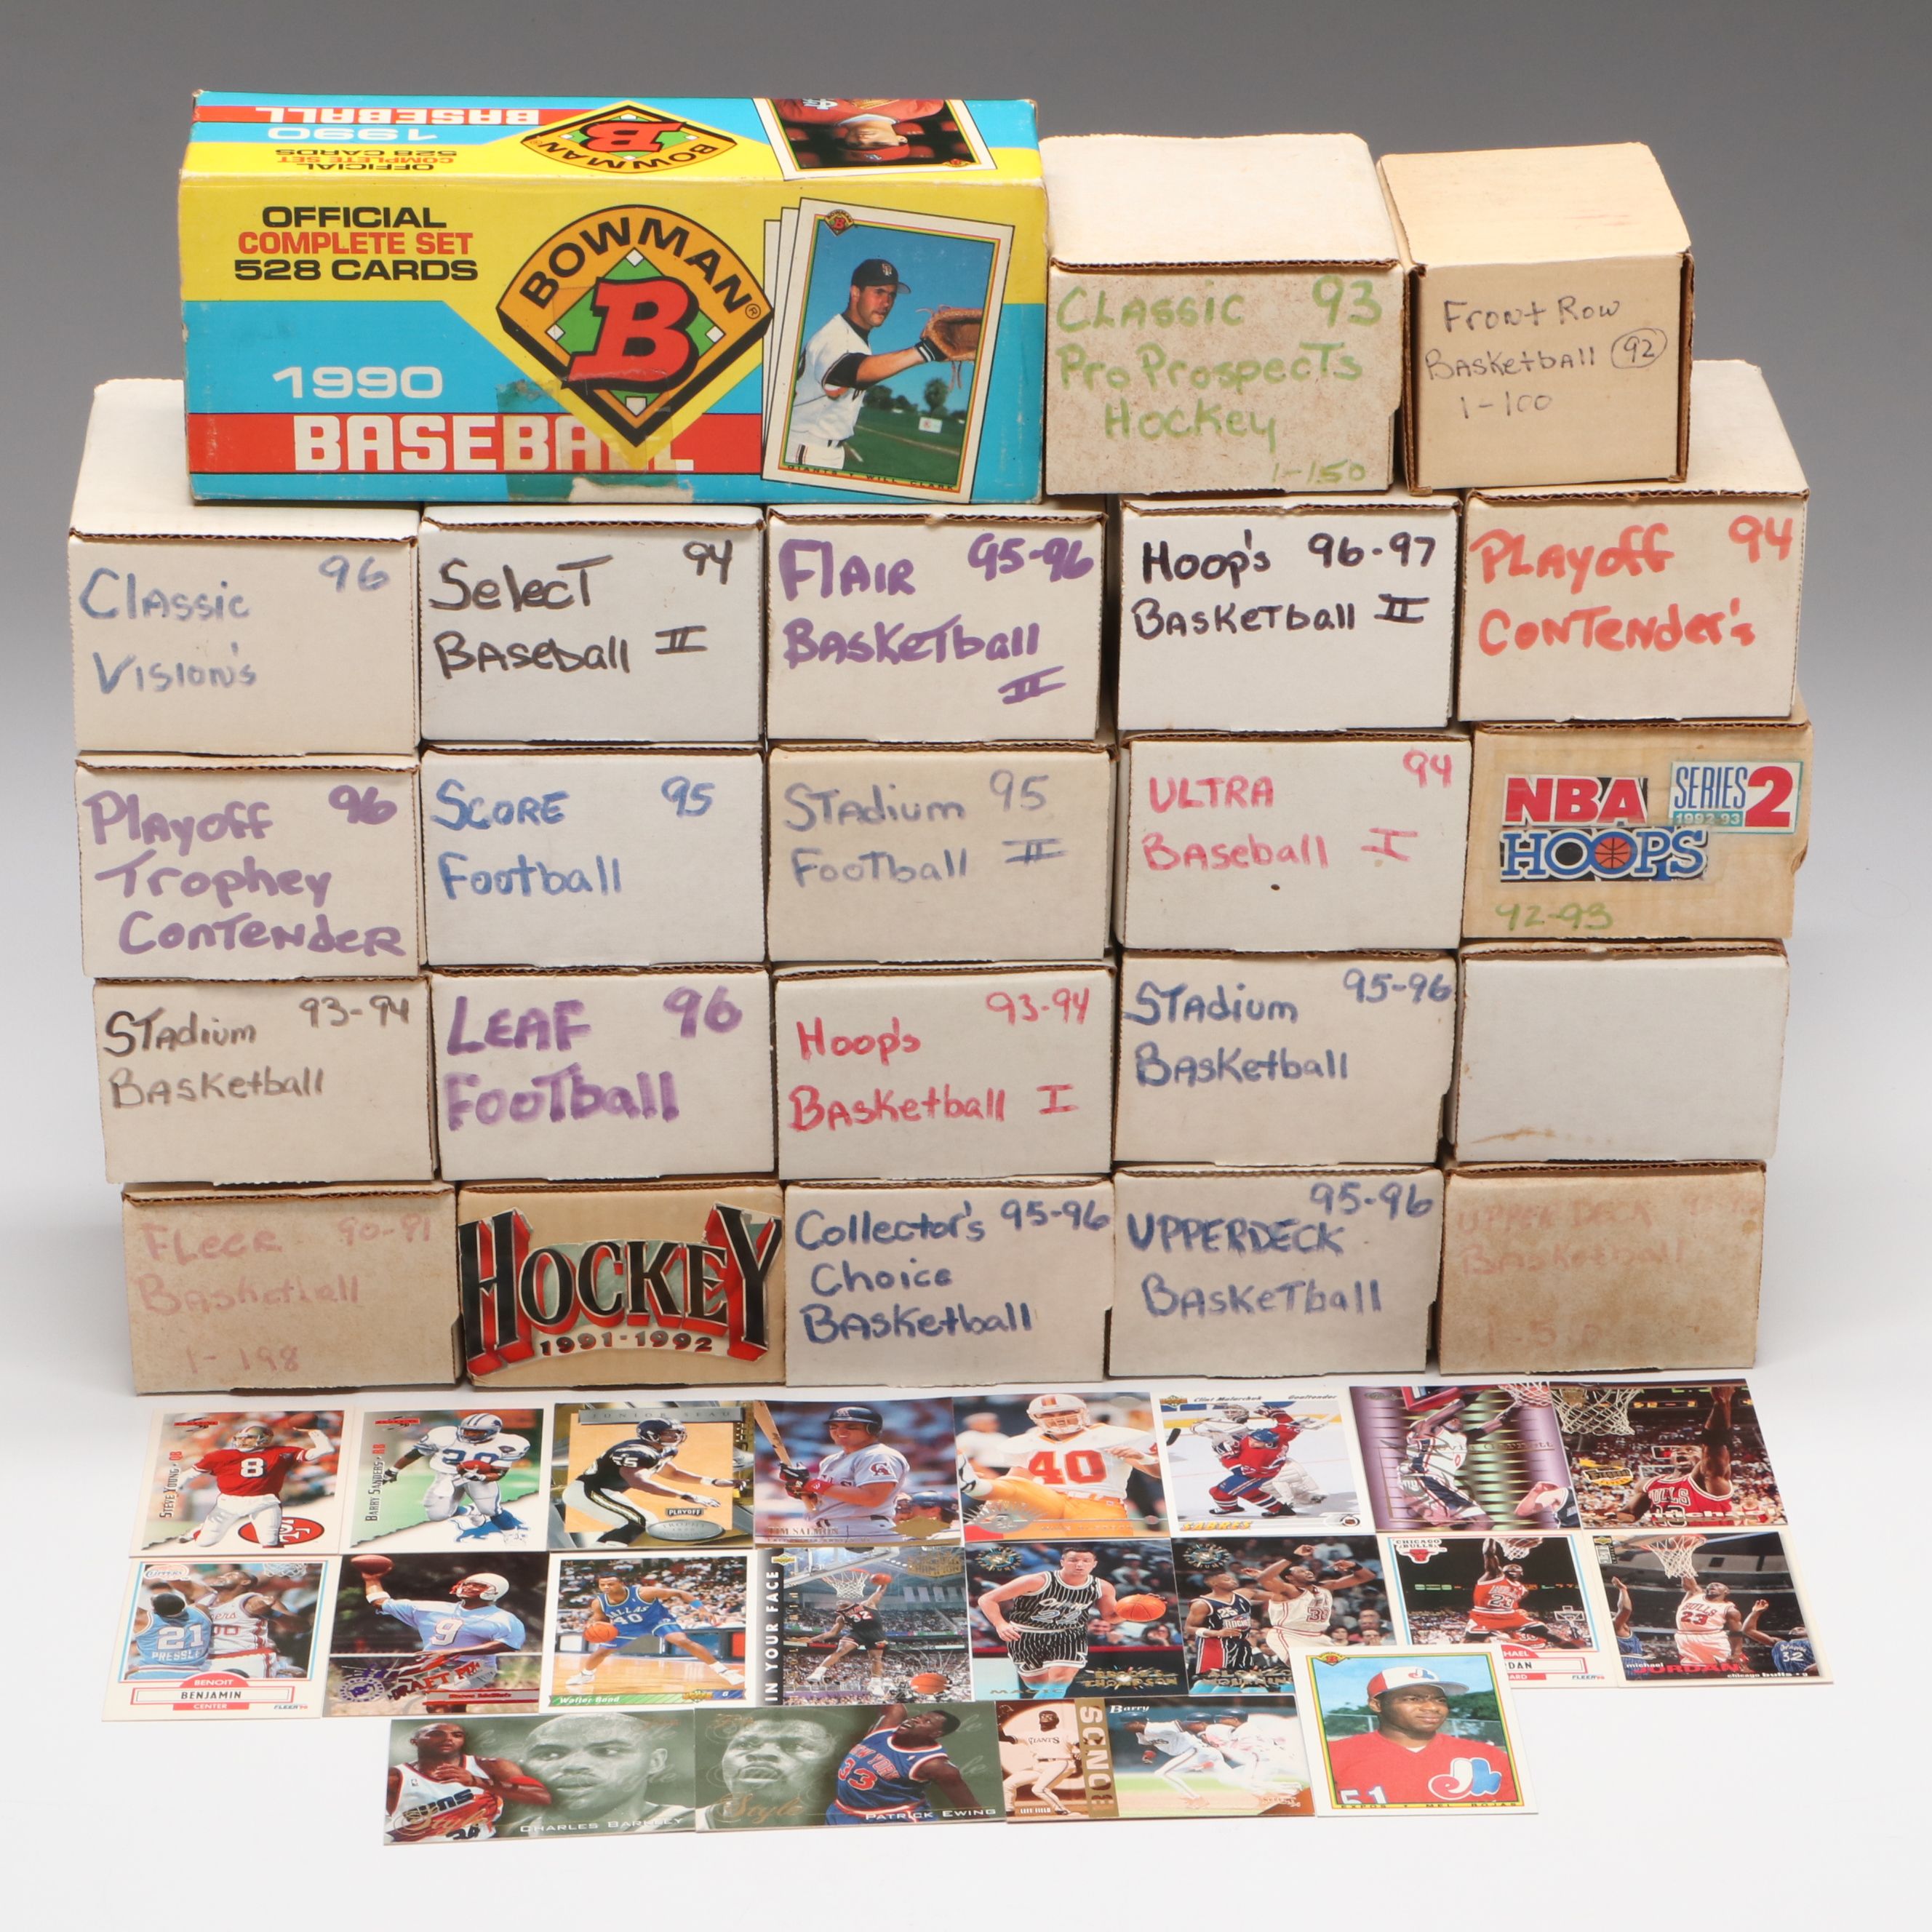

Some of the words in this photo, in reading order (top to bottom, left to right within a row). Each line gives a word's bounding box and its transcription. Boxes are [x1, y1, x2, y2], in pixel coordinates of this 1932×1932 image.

[256, 107, 539, 125] BASEBALL
[268, 127, 438, 141] 1990
[275, 148, 359, 156] CARDS
[396, 148, 458, 157] 528
[537, 141, 719, 169] BOWMAN
[261, 206, 447, 228] OFFICIAL
[238, 232, 406, 255] COMPLETE
[415, 232, 474, 255] SET
[234, 260, 322, 281] 528
[332, 259, 479, 281] CARDS
[519, 216, 757, 314] BOWMAN
[1310, 276, 1382, 330] 93
[272, 366, 443, 399] 1990
[1309, 531, 1437, 568] 96-97
[1728, 515, 1795, 564] 94
[318, 553, 391, 593] 96
[682, 540, 734, 586] 94
[967, 532, 1095, 583] 95-96
[660, 775, 715, 819] 95
[989, 768, 1052, 814] 95
[1148, 775, 1274, 813] ULTRA
[1402, 750, 1454, 789] 94
[1505, 776, 1647, 824] NBA
[1674, 766, 1747, 809] SERIES
[1745, 766, 1794, 828] 2
[327, 784, 399, 826] 96
[1501, 828, 1709, 877] HOOPS
[1343, 967, 1453, 1005] 95-96
[299, 994, 410, 1029] 93-94
[447, 994, 591, 1055] LEAF
[662, 986, 743, 1039] 96
[984, 988, 1090, 1025] 93-94
[999, 1199, 1112, 1232] 95-96
[1309, 1181, 1436, 1221] 95-96
[459, 1203, 783, 1376] HOCKEY
[810, 1258, 954, 1299] Choice
[539, 1328, 714, 1358] 1991-1992
[241, 1457, 266, 1478] 8
[1028, 1449, 1106, 1485] 40
[1181, 1520, 1253, 1531] SABRES
[766, 1571, 779, 1613] FACE
[613, 1613, 644, 1625] 40
[1217, 1606, 1239, 1618] 25
[1680, 1610, 1709, 1625] 23
[157, 1624, 204, 1650] 21
[431, 1617, 464, 1647] 9
[765, 1623, 779, 1672] YOUR
[193, 1679, 234, 1687] BENOIT
[1633, 1664, 1741, 1674] JORDAN
[180, 1691, 242, 1700] BENJAMIN
[765, 1682, 778, 1702] IN
[1109, 1704, 1150, 1714] Barry
[838, 1757, 877, 1791] 33
[519, 1821, 599, 1833] CHARLES
[608, 1817, 684, 1829] BARKLEY
[866, 1810, 933, 1821] PATRICK
[942, 1807, 997, 1816] EWING
